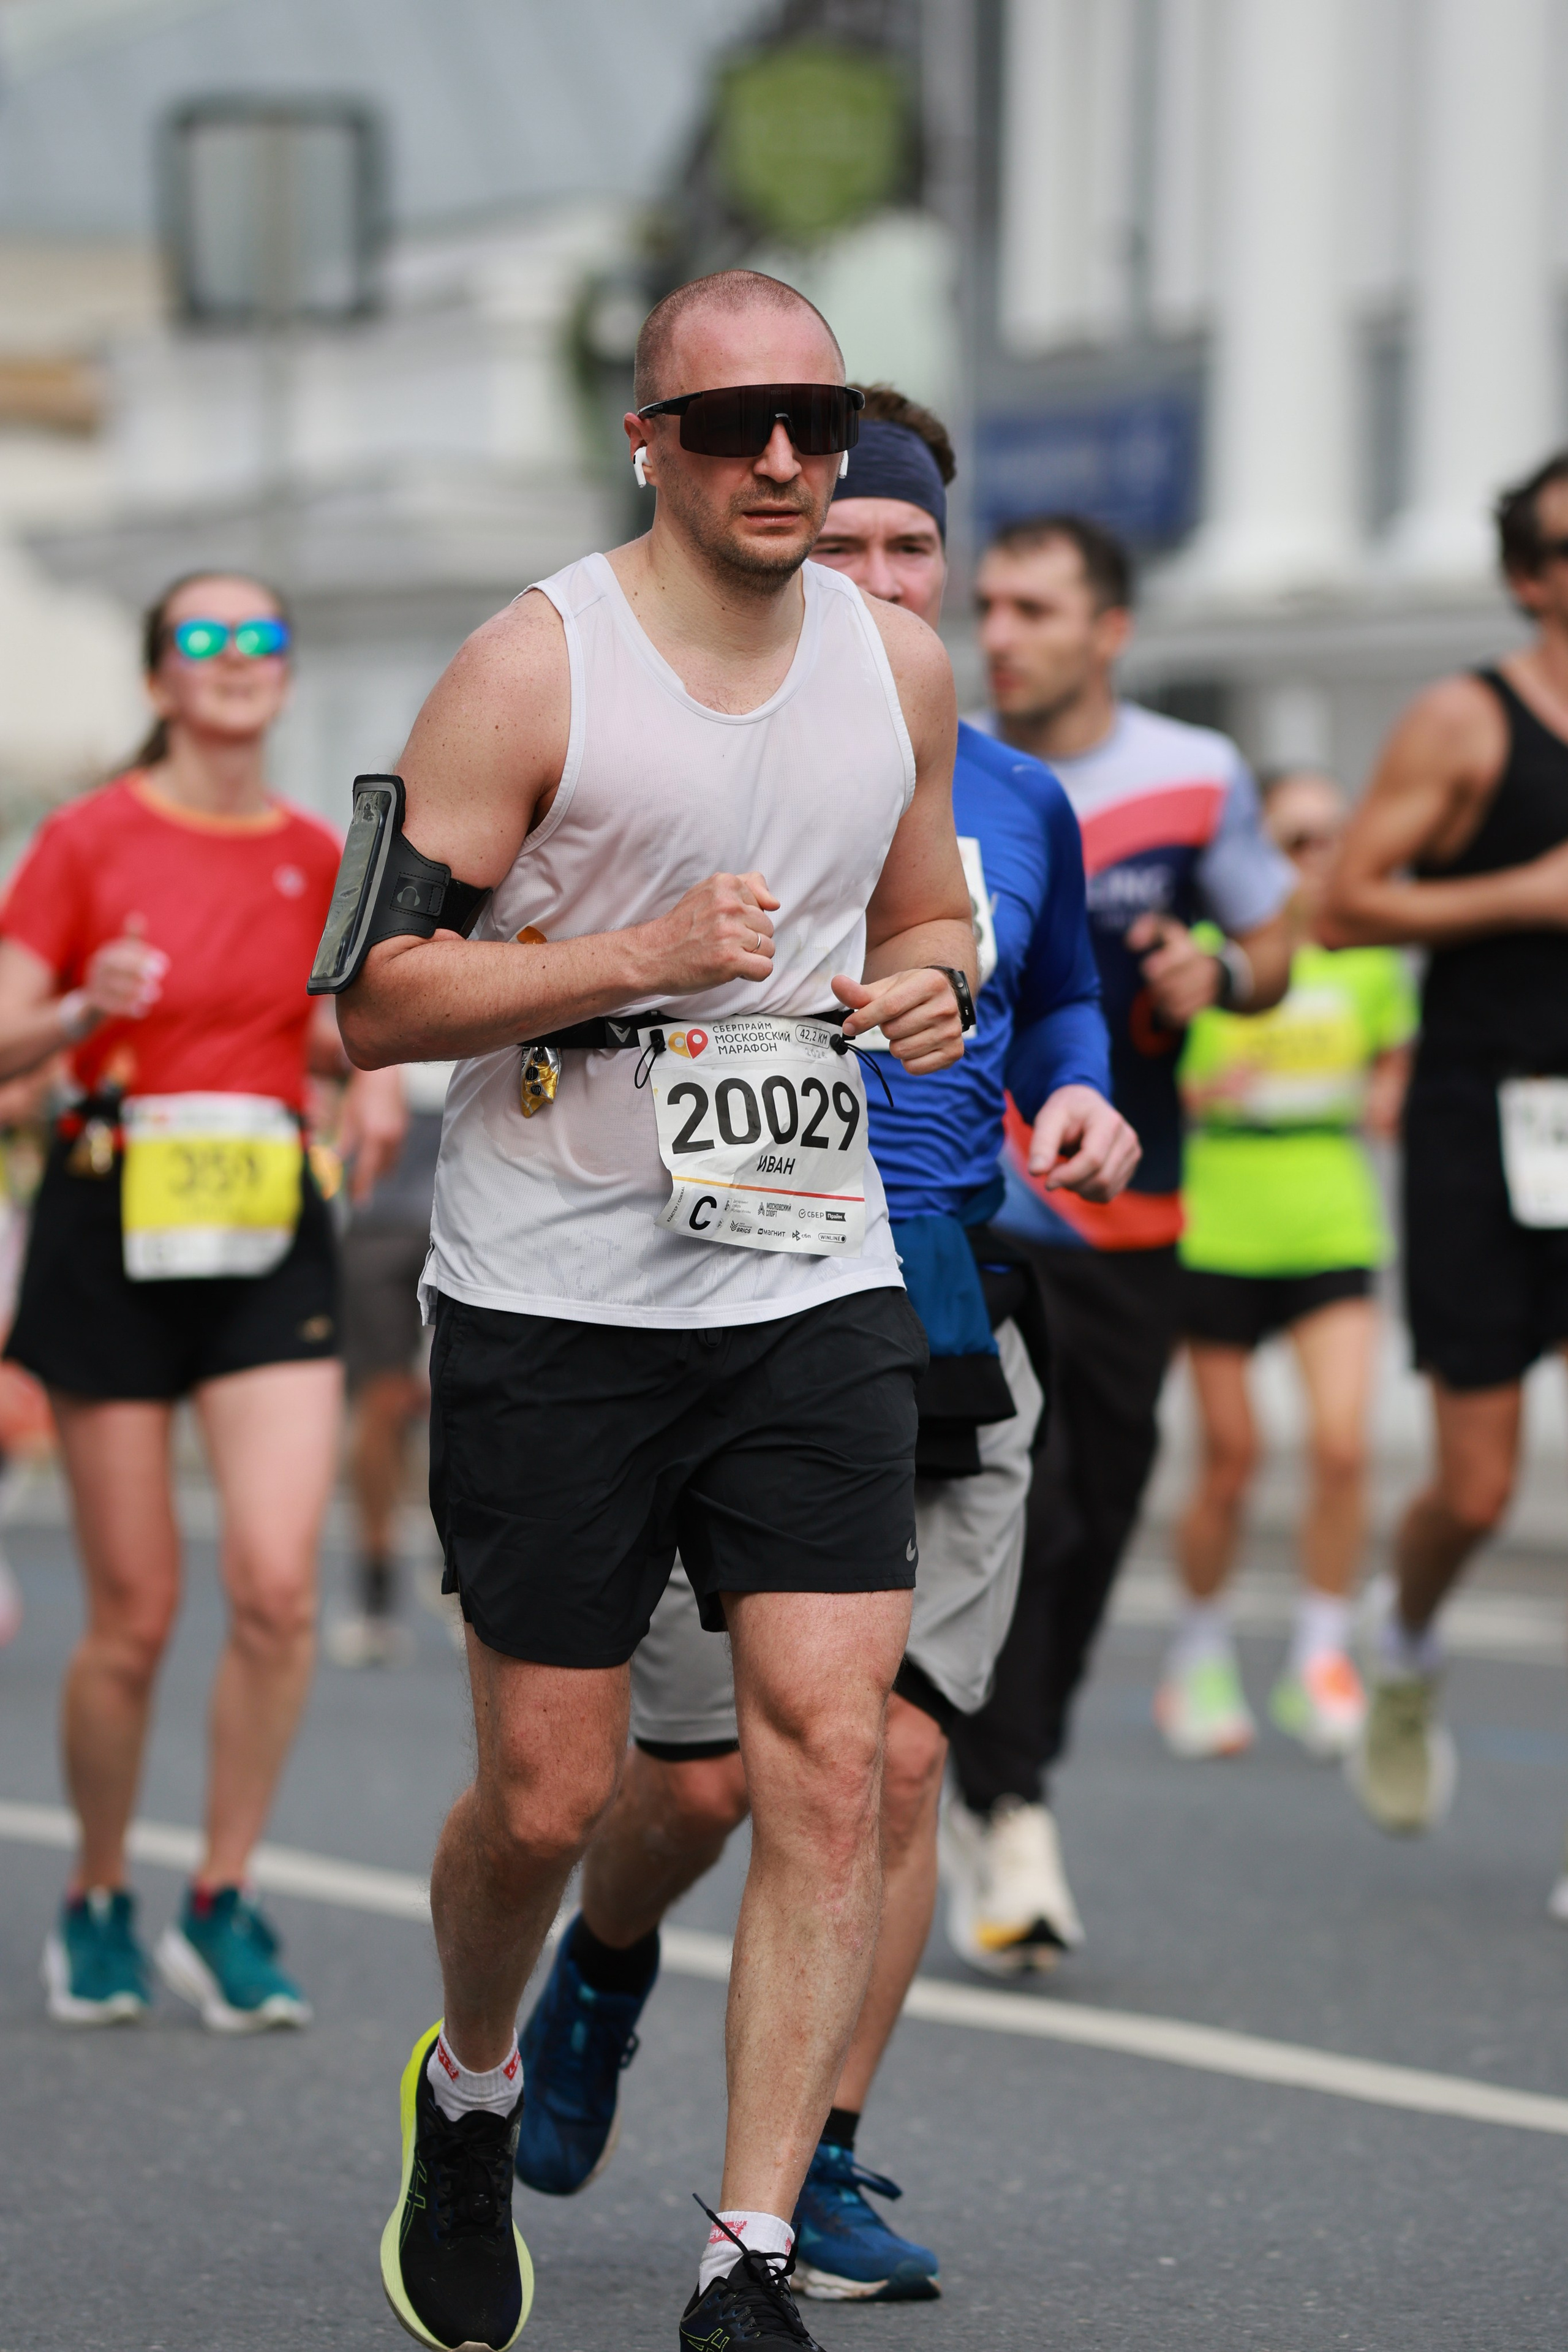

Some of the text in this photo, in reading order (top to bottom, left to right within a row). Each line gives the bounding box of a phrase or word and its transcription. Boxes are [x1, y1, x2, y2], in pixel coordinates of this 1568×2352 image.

[712, 1022, 772, 1033] СБЕРПРАЙМ
[715, 1031, 791, 1044] МОСКОВСКИЙ
[800, 1029, 827, 1044] 42,2 КМ
[718, 1042, 778, 1055] МАРАФОН
[667, 1075, 860, 1155] 20029
[756, 1155, 796, 1175] ИВАН
[766, 1202, 792, 1212] МОСКОВСКИЙ
[666, 1206, 678, 1223] КЛАСТЕР
